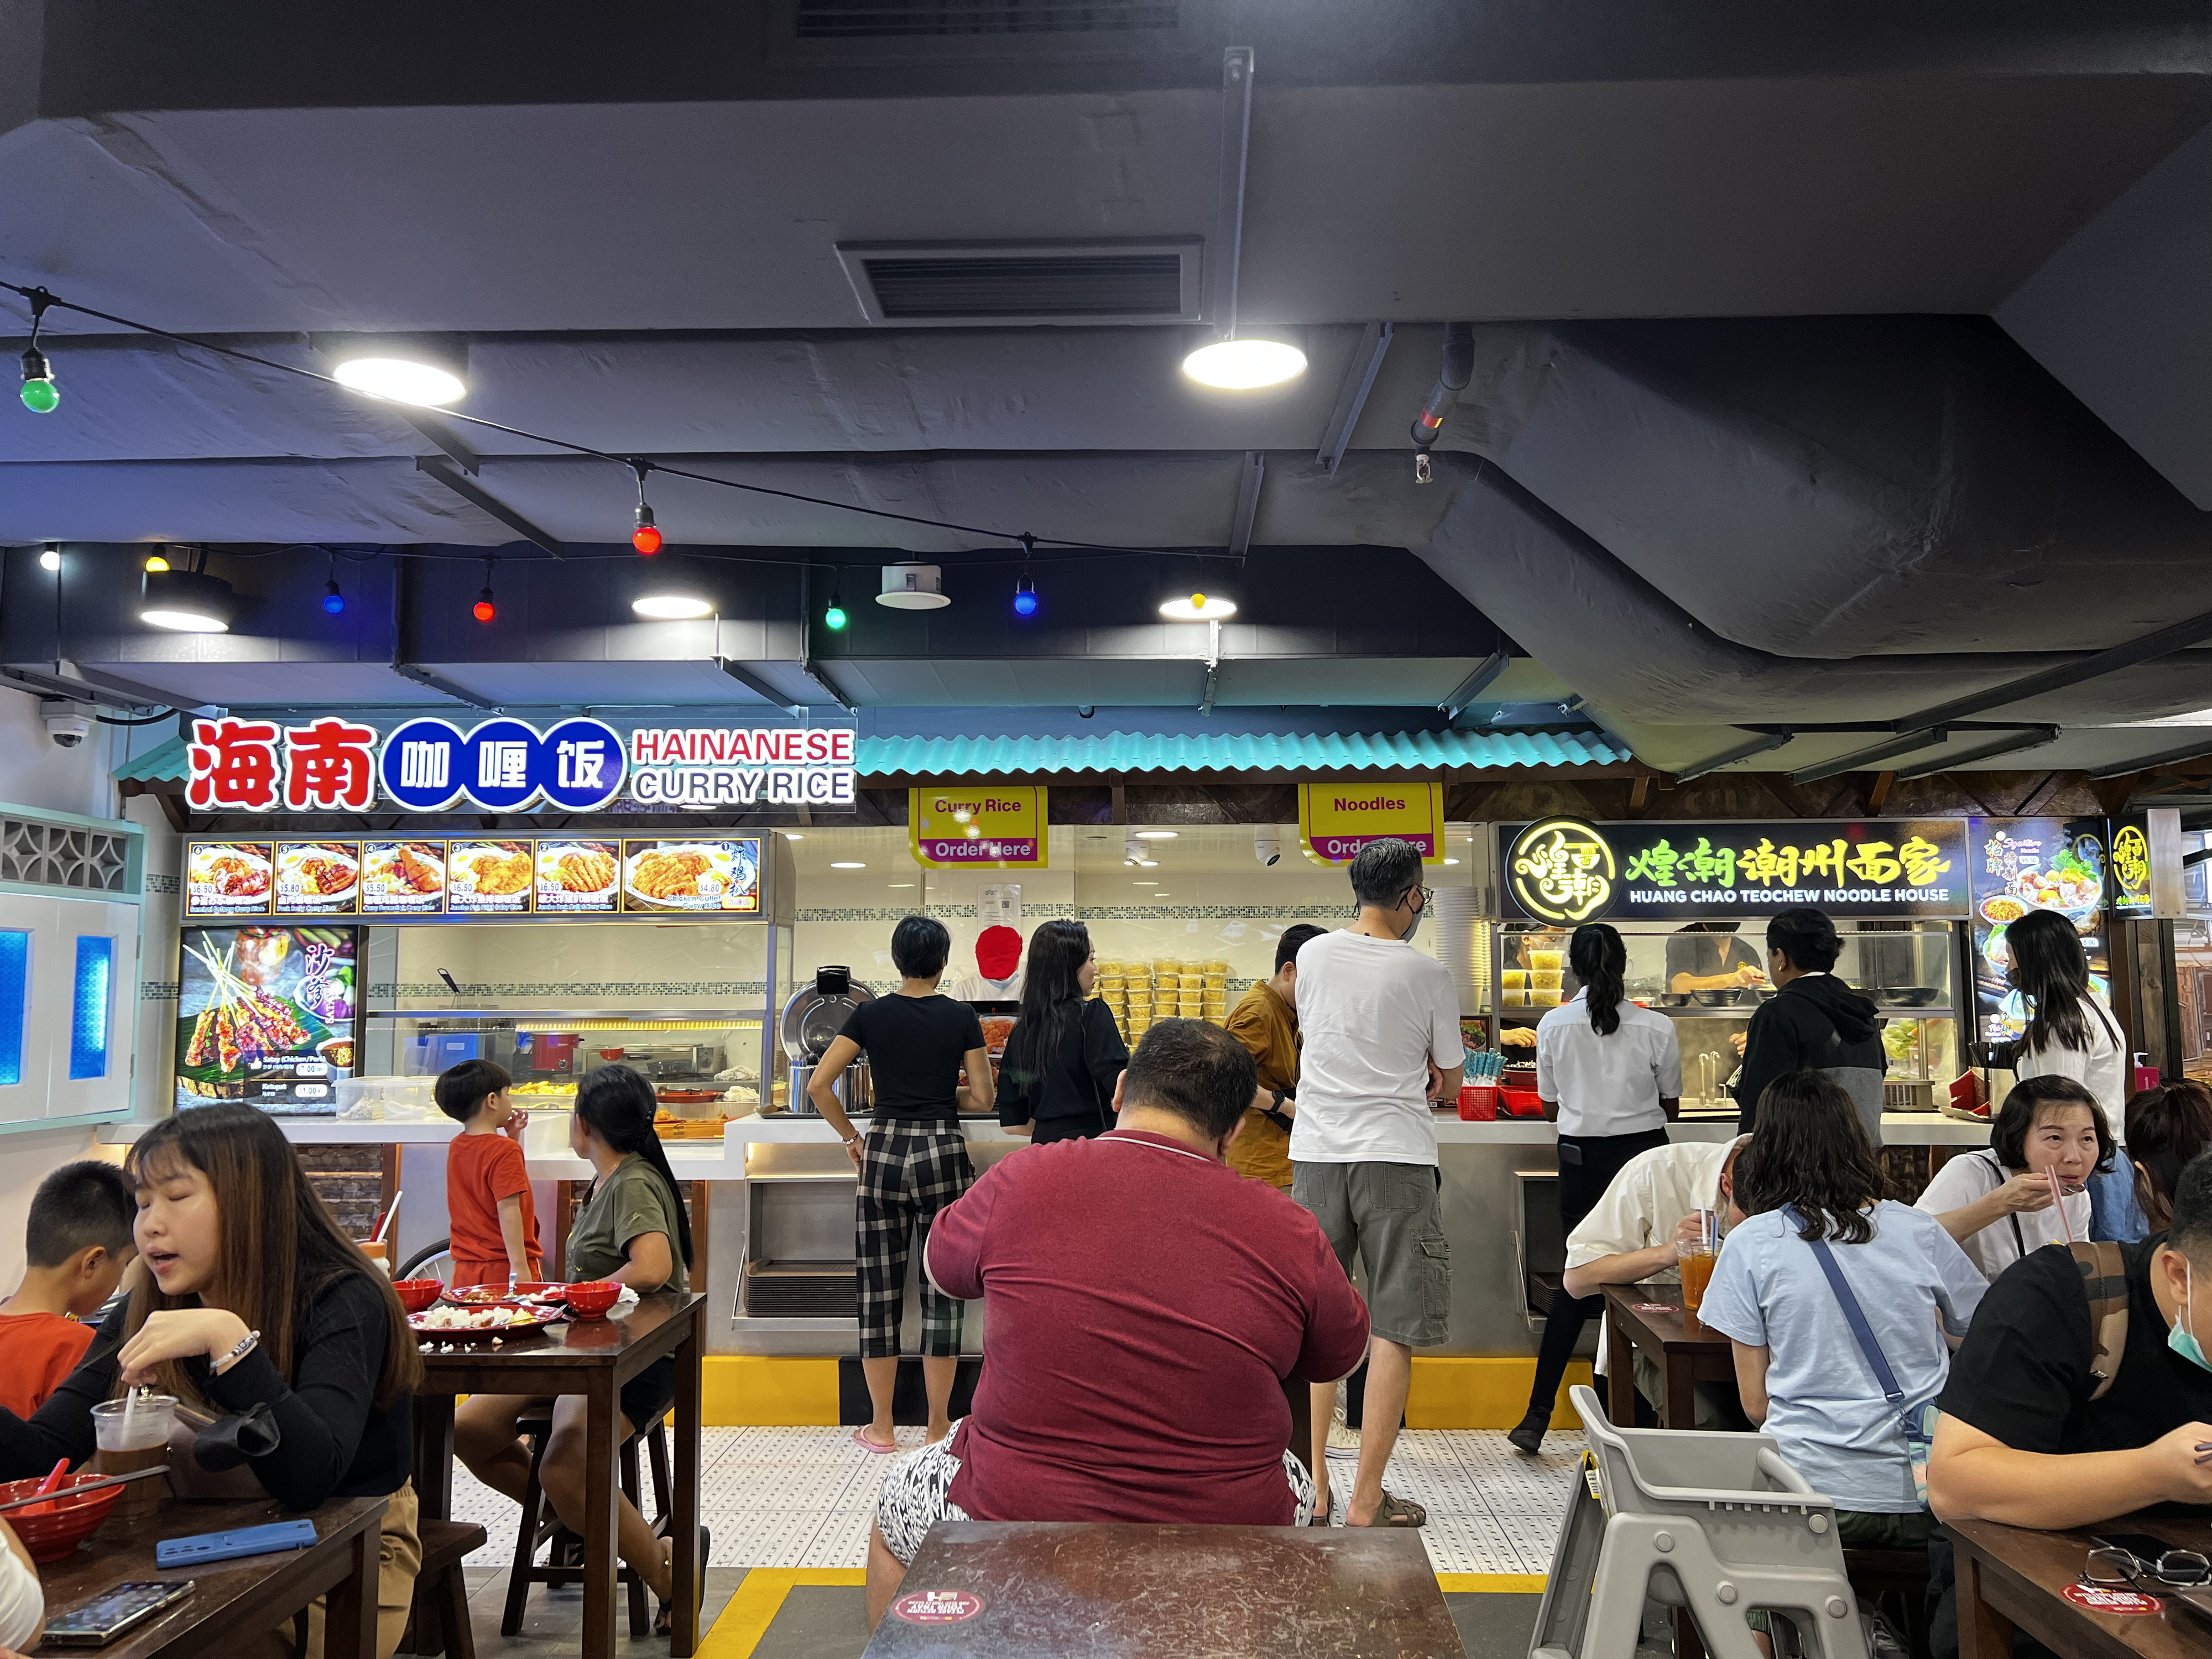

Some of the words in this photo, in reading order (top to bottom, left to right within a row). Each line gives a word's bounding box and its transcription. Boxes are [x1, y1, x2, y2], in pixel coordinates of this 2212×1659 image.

[635, 733, 851, 761] HAINANESE
[189, 720, 604, 808] 海南咖喱饭
[635, 771, 760, 800] CURRY
[772, 771, 850, 799] RICE
[935, 800, 982, 815] Curry
[985, 799, 1021, 812] Rice
[1334, 796, 1406, 812] Noodles
[935, 842, 986, 857] Order
[989, 841, 1031, 856] Here
[1327, 839, 1369, 854] Ord
[1625, 836, 1951, 889] 煌潮潮州面家
[1984, 839, 2004, 876] 招牌
[729, 847, 749, 897] 炸鸡扒
[280, 884, 299, 893] $5.80
[366, 884, 385, 893] $5.50
[453, 884, 472, 892] $6.50
[540, 883, 559, 891] $6.50
[701, 884, 719, 893] $4.80
[1630, 889, 1688, 903] HUANG
[1690, 889, 1738, 903] CHAO
[1740, 889, 1820, 902] TEOCHEW
[1824, 889, 1892, 902] NOODLE
[1894, 888, 1949, 902] HOUSE
[306, 943, 335, 1009] 沙爹
